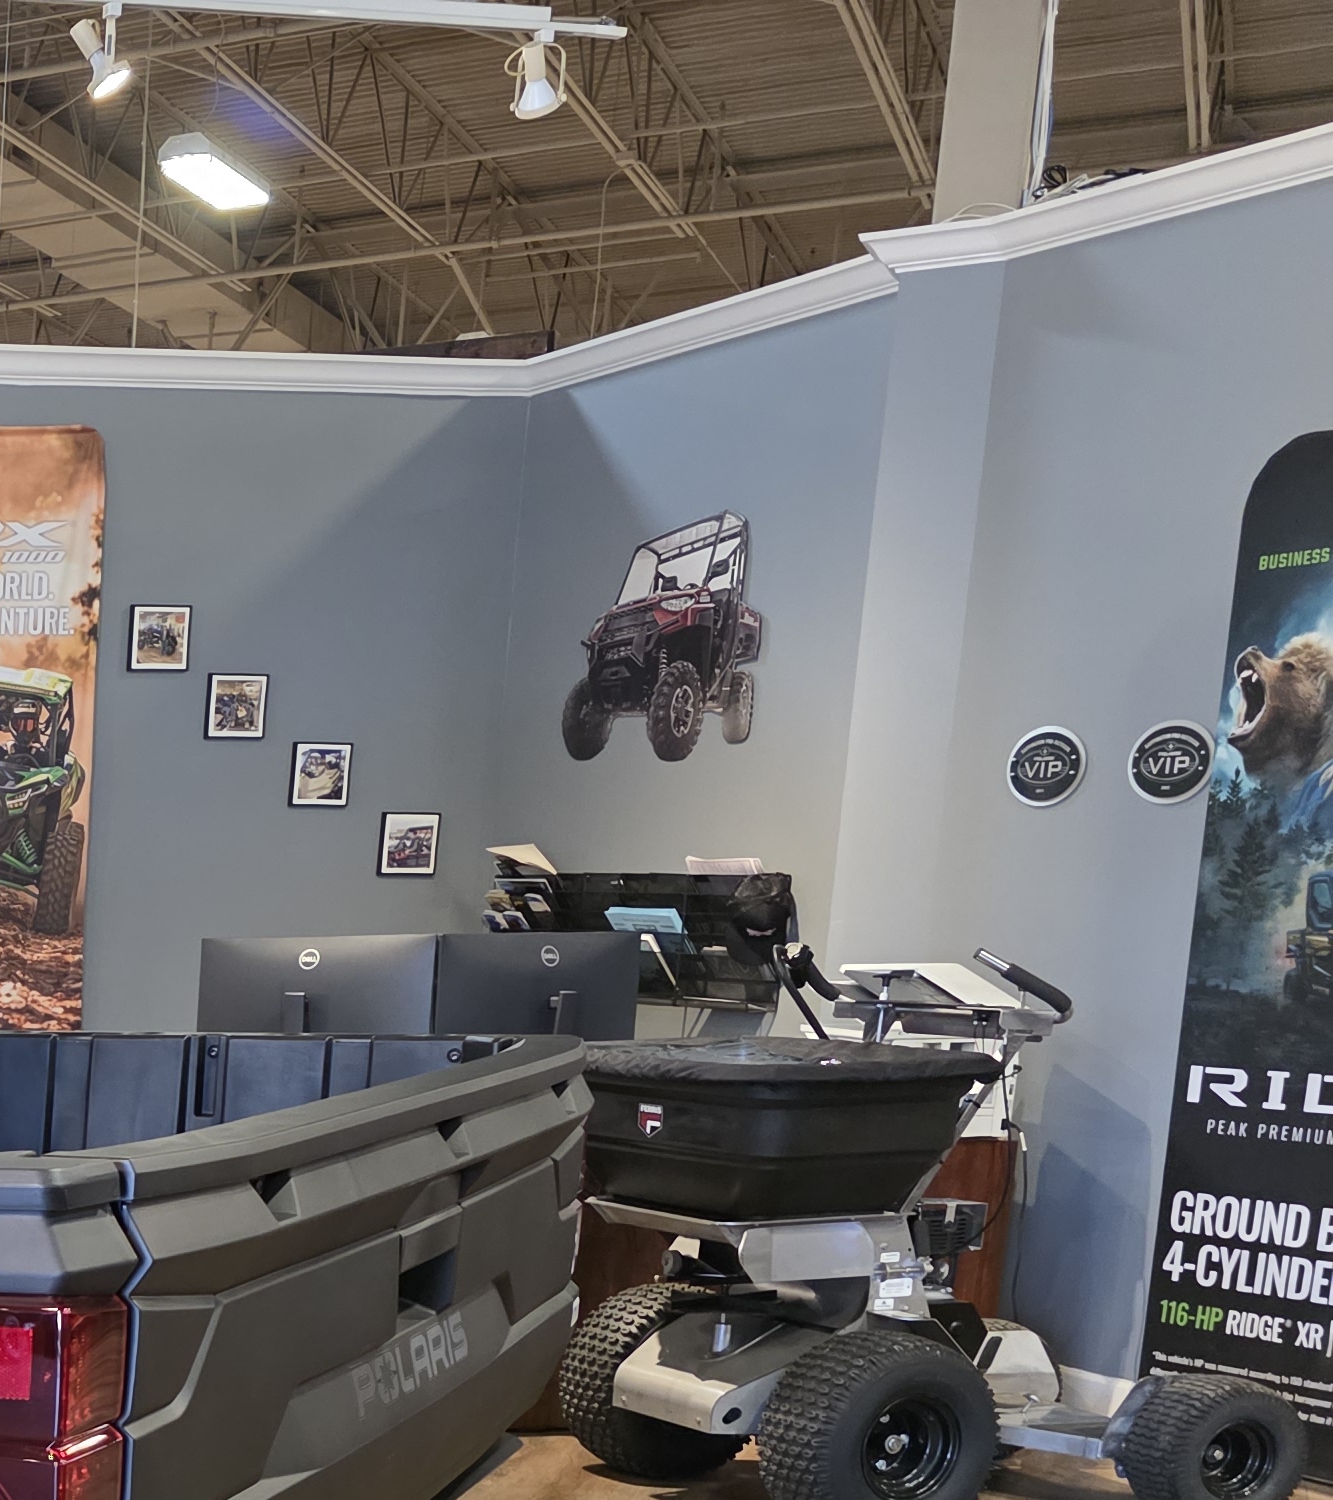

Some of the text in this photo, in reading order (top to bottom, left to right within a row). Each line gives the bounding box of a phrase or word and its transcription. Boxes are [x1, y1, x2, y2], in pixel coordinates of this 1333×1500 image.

[2, 550, 66, 563] 1000
[1258, 547, 1331, 571] BUSINESS
[1025, 761, 1063, 778] VIP
[1148, 756, 1190, 775] VIP
[1206, 1118, 1248, 1138] PEAK
[1170, 1190, 1311, 1249] GROUND
[1162, 1240, 1333, 1306] 4-CYLINDE
[1159, 1299, 1224, 1332] 116-HP
[1294, 1320, 1325, 1350] XR
[351, 1311, 468, 1420] POLARIS
